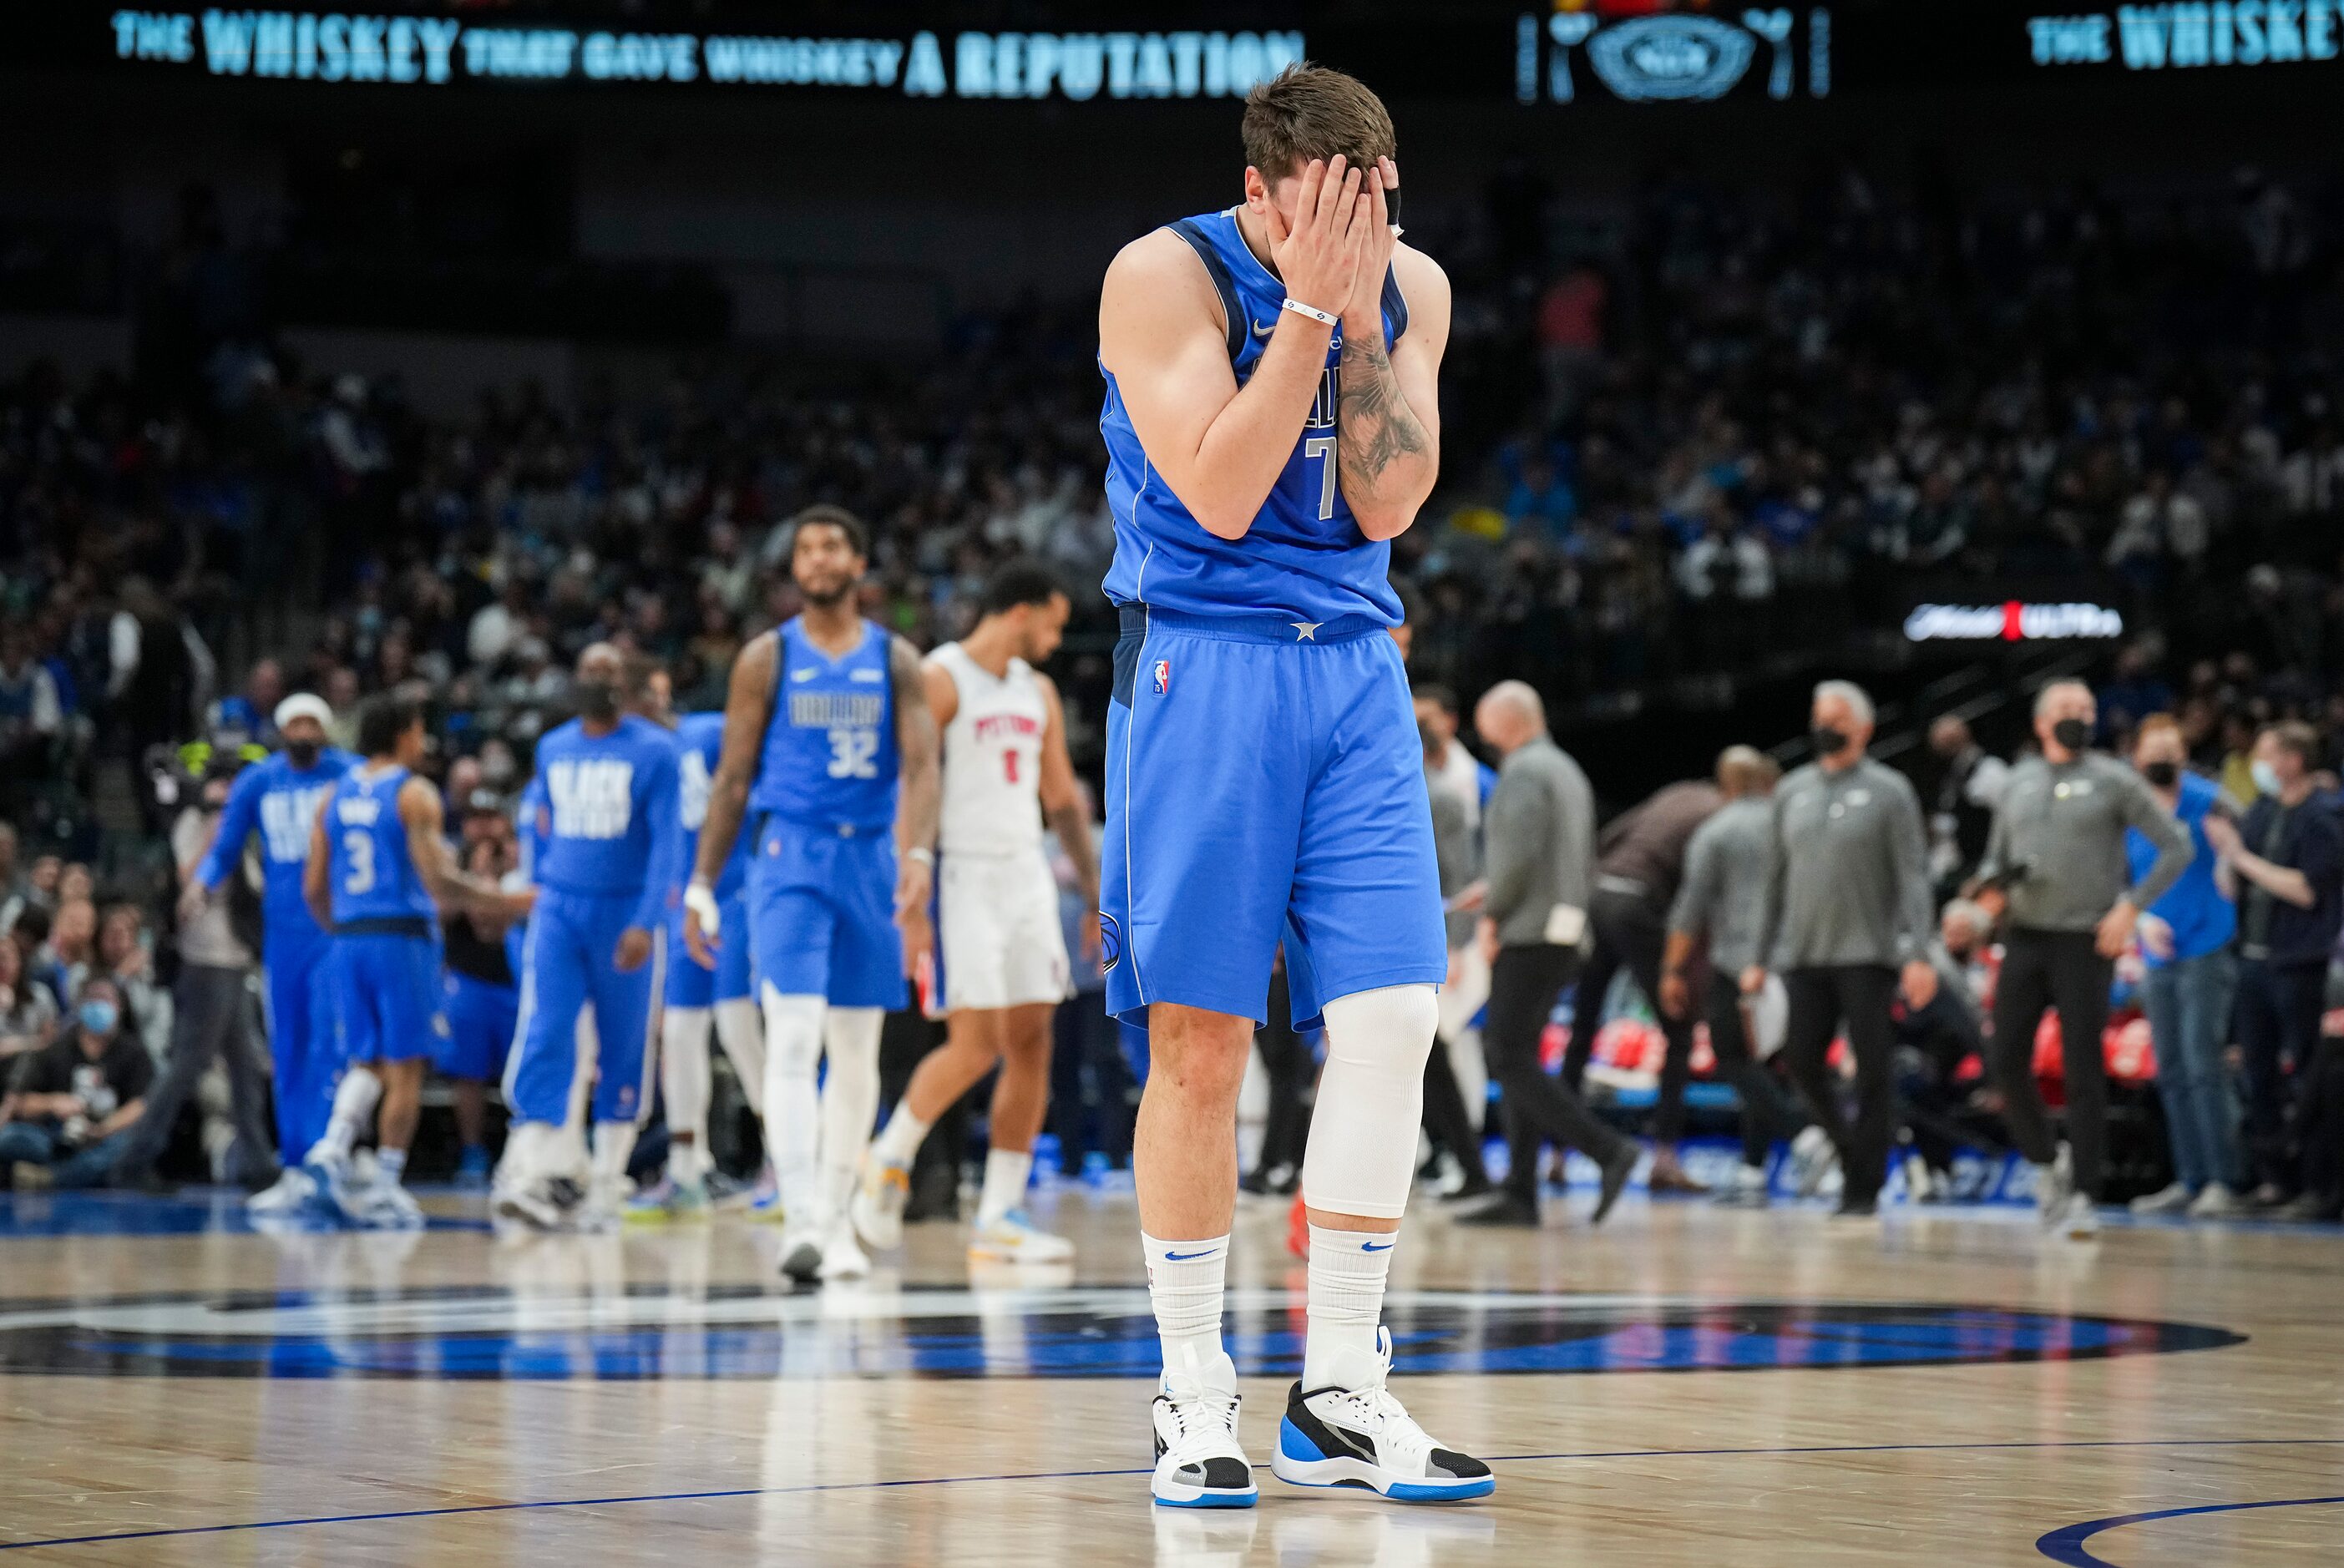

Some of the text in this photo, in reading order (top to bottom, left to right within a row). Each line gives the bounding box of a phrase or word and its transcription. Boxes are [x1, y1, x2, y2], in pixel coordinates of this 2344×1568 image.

[113, 11, 193, 61] THE
[202, 9, 458, 83] WHISKEY
[461, 28, 578, 77] THAT
[582, 33, 697, 80] GAVE
[904, 32, 945, 96] A
[955, 32, 1304, 99] REPUTATION
[2028, 14, 2111, 65] THE
[828, 730, 878, 777] 32
[345, 829, 374, 893] 3
